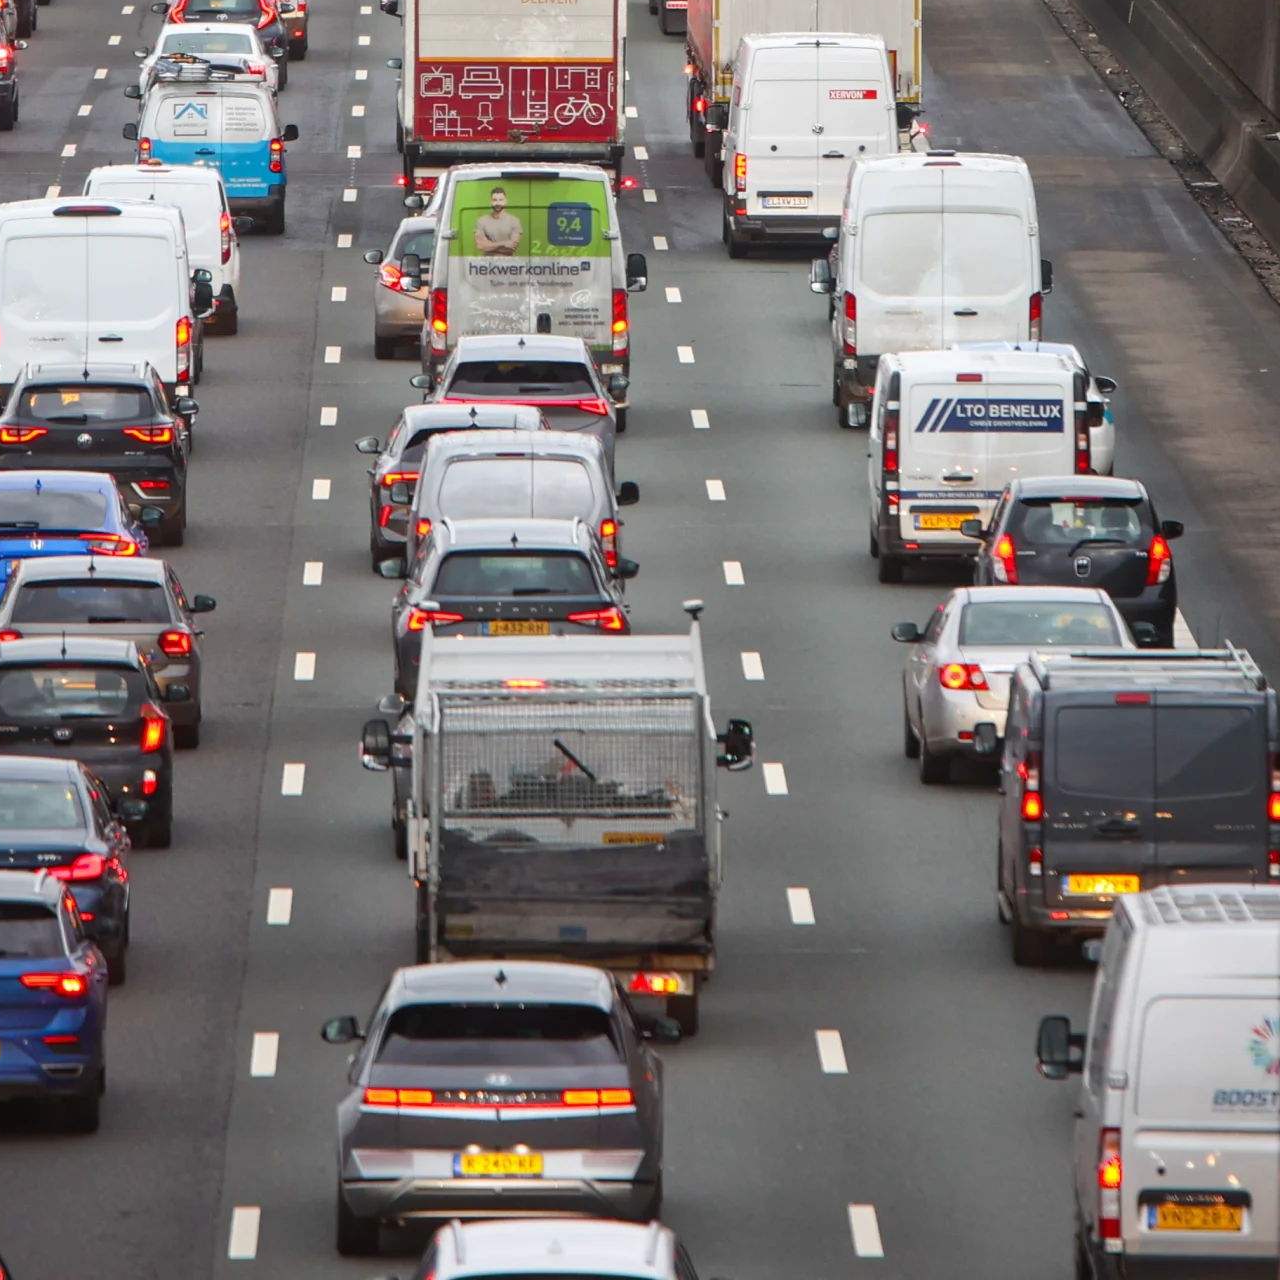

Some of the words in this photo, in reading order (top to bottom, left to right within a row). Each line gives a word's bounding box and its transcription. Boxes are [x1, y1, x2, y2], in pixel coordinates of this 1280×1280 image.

[557, 217, 582, 234] 9,4
[469, 262, 580, 276] hekwerkonline
[956, 404, 985, 418] LTO
[989, 405, 1061, 418] BENELUX
[1213, 1090, 1280, 1107] BOOST
